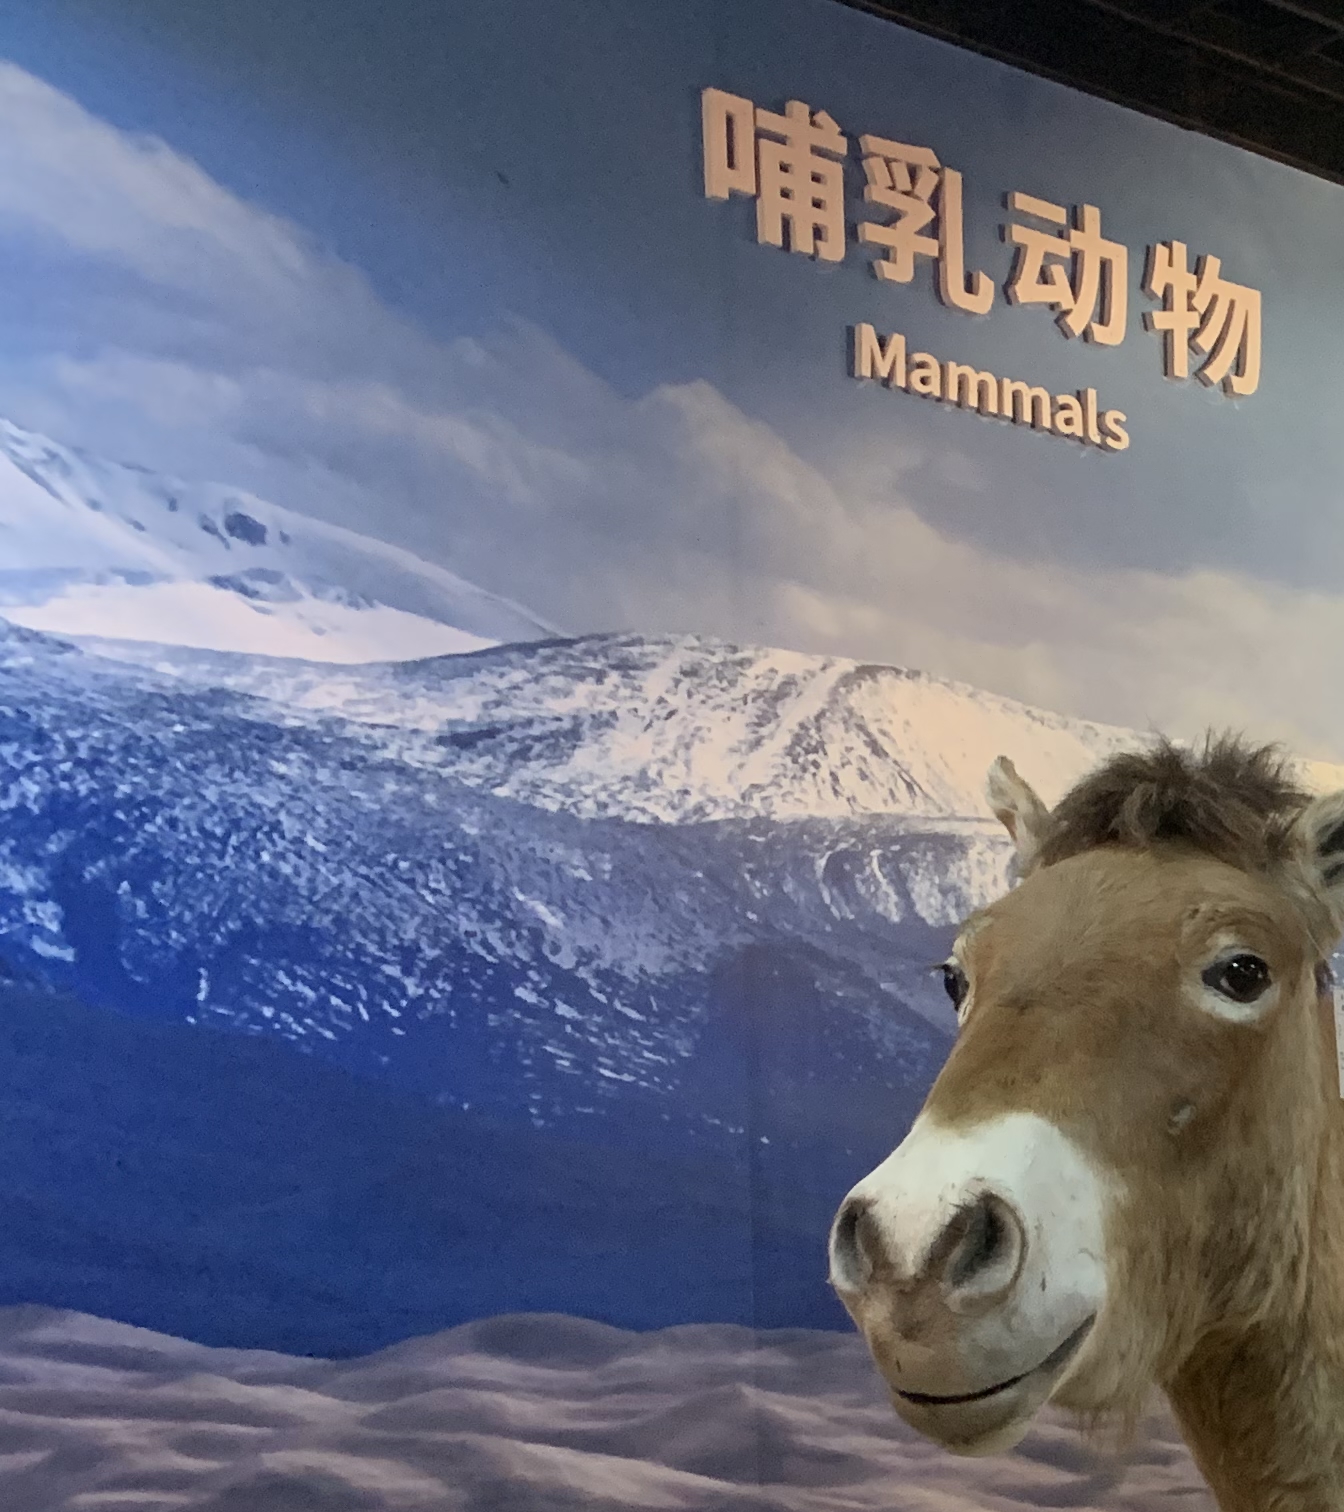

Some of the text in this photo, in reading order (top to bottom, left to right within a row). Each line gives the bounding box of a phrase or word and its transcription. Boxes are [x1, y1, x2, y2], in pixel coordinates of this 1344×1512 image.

[702, 87, 1262, 395] 哺乳动物
[854, 323, 1130, 451] Mammals
